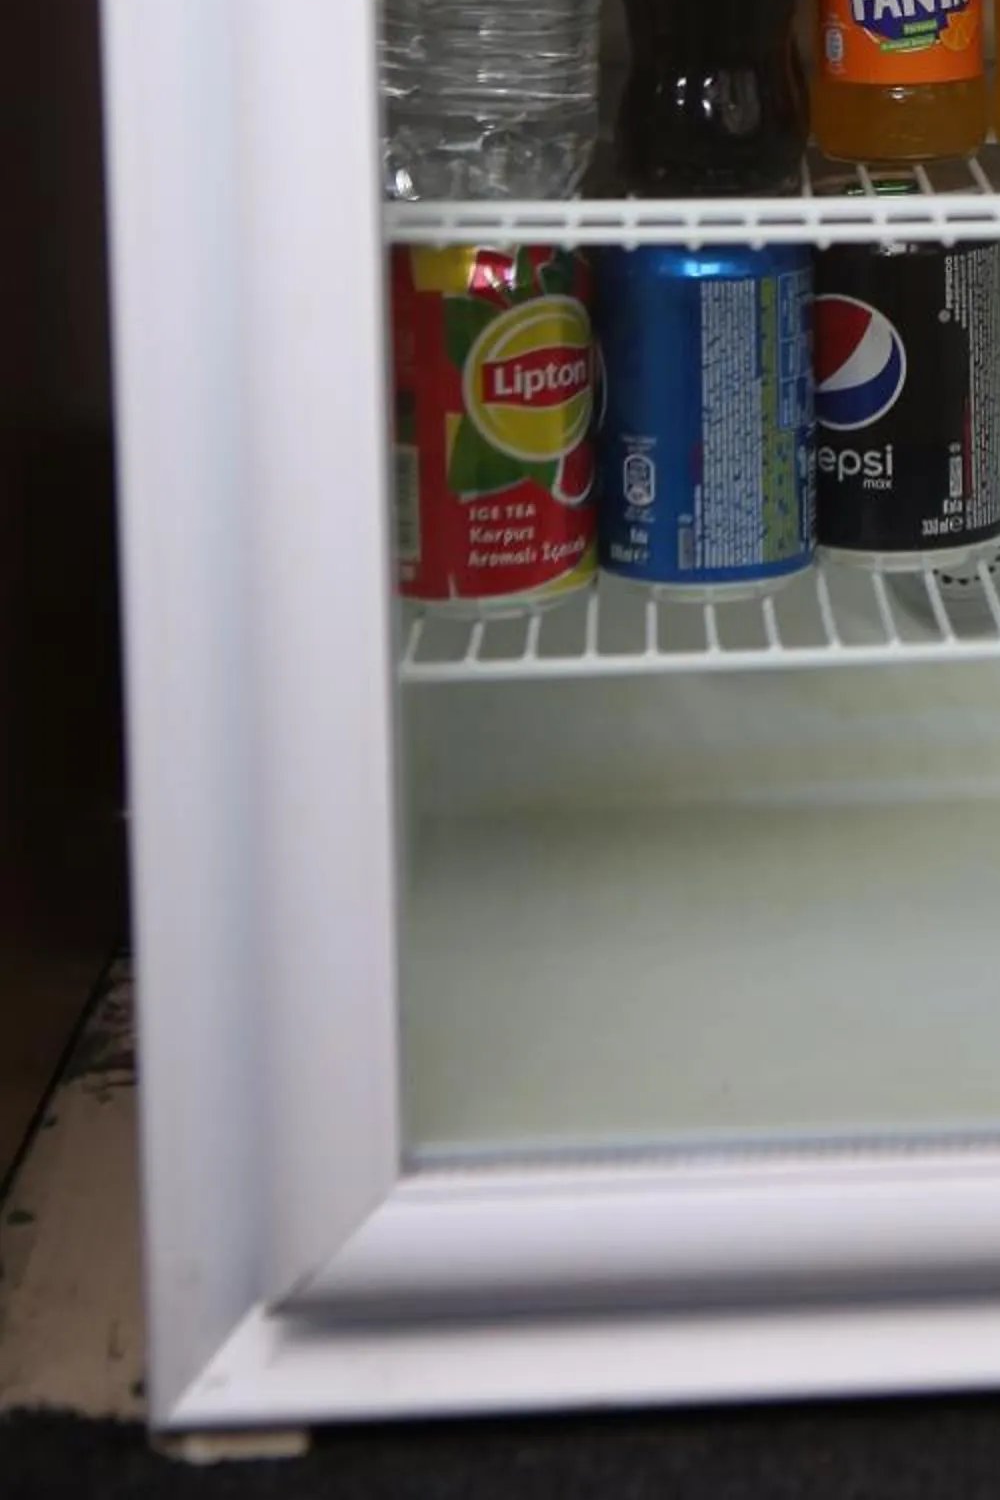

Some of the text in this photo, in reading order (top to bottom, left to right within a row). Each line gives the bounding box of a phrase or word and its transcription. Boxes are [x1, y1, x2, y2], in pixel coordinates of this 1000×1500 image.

[493, 359, 587, 399] Lipton
[863, 478, 892, 489] max
[505, 503, 536, 518] TEA
